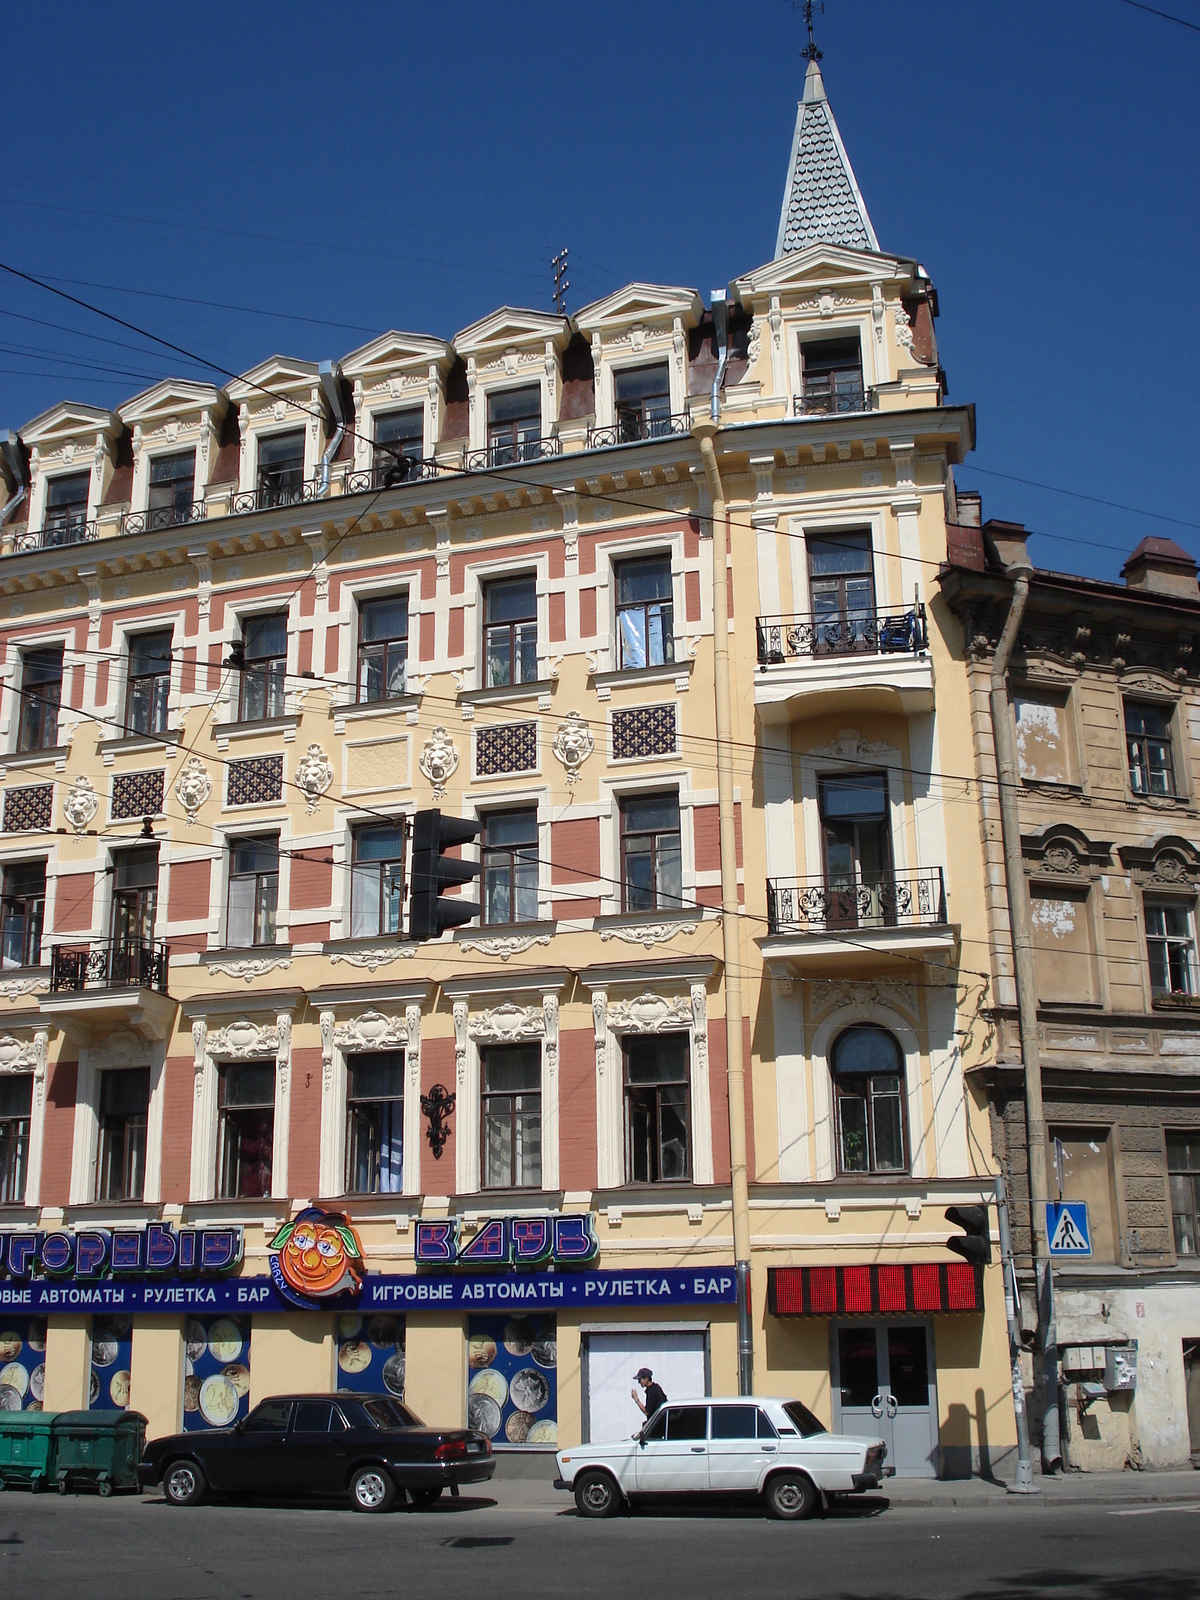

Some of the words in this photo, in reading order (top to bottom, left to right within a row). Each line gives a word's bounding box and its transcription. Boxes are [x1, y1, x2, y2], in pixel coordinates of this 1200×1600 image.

[269, 1255, 288, 1289] CRAZY
[0, 1289, 32, 1303] ВЫЕ
[39, 1288, 125, 1304] АВТОМАТЫ
[143, 1287, 217, 1303] РУЛЕТКА
[237, 1286, 270, 1302] БАР
[372, 1284, 453, 1301] ИГРОВЫЕ
[461, 1281, 564, 1300] АВТОМАТЫ
[584, 1279, 672, 1297] РУЛЕТКА
[693, 1277, 732, 1295] БАР
